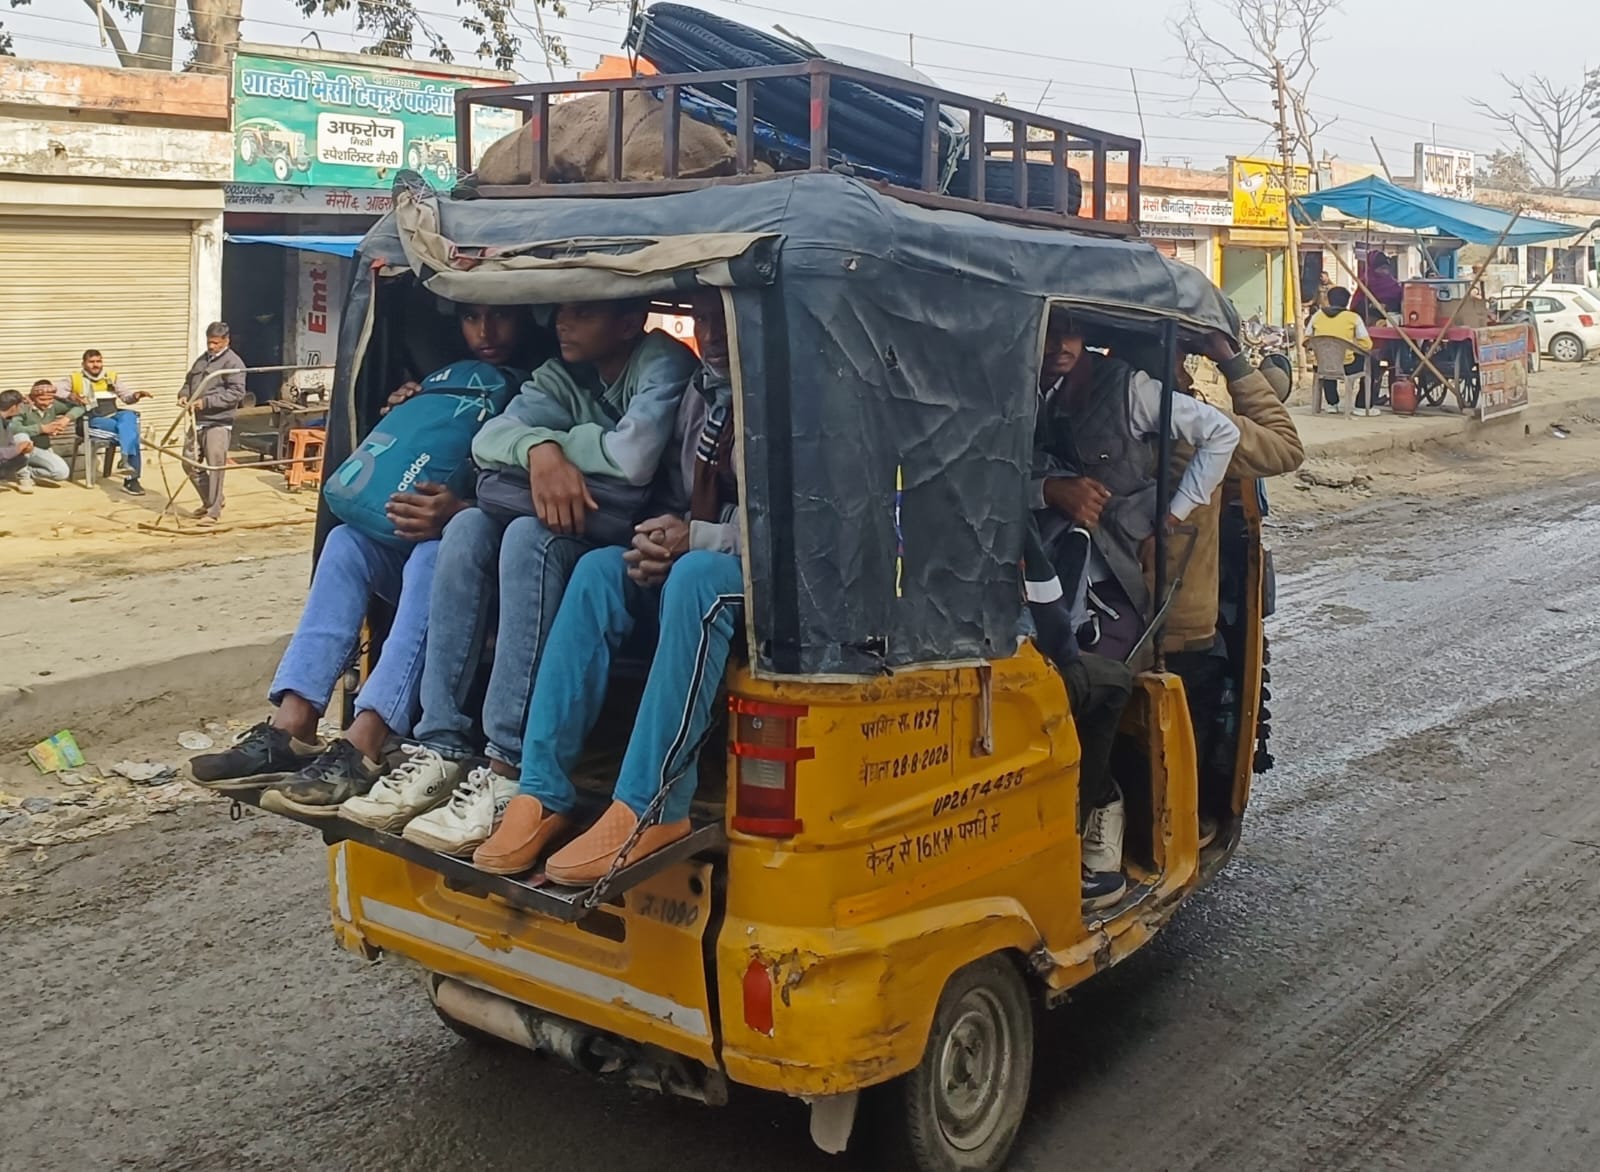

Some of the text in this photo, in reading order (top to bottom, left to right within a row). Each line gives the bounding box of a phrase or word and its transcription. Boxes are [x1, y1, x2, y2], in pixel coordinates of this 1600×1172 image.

[242, 69, 310, 101] शाहजी
[311, 71, 352, 105] मैसी
[404, 85, 456, 115] वर्कशॉ
[327, 119, 396, 139] अफरोज
[397, 452, 431, 492] adidas
